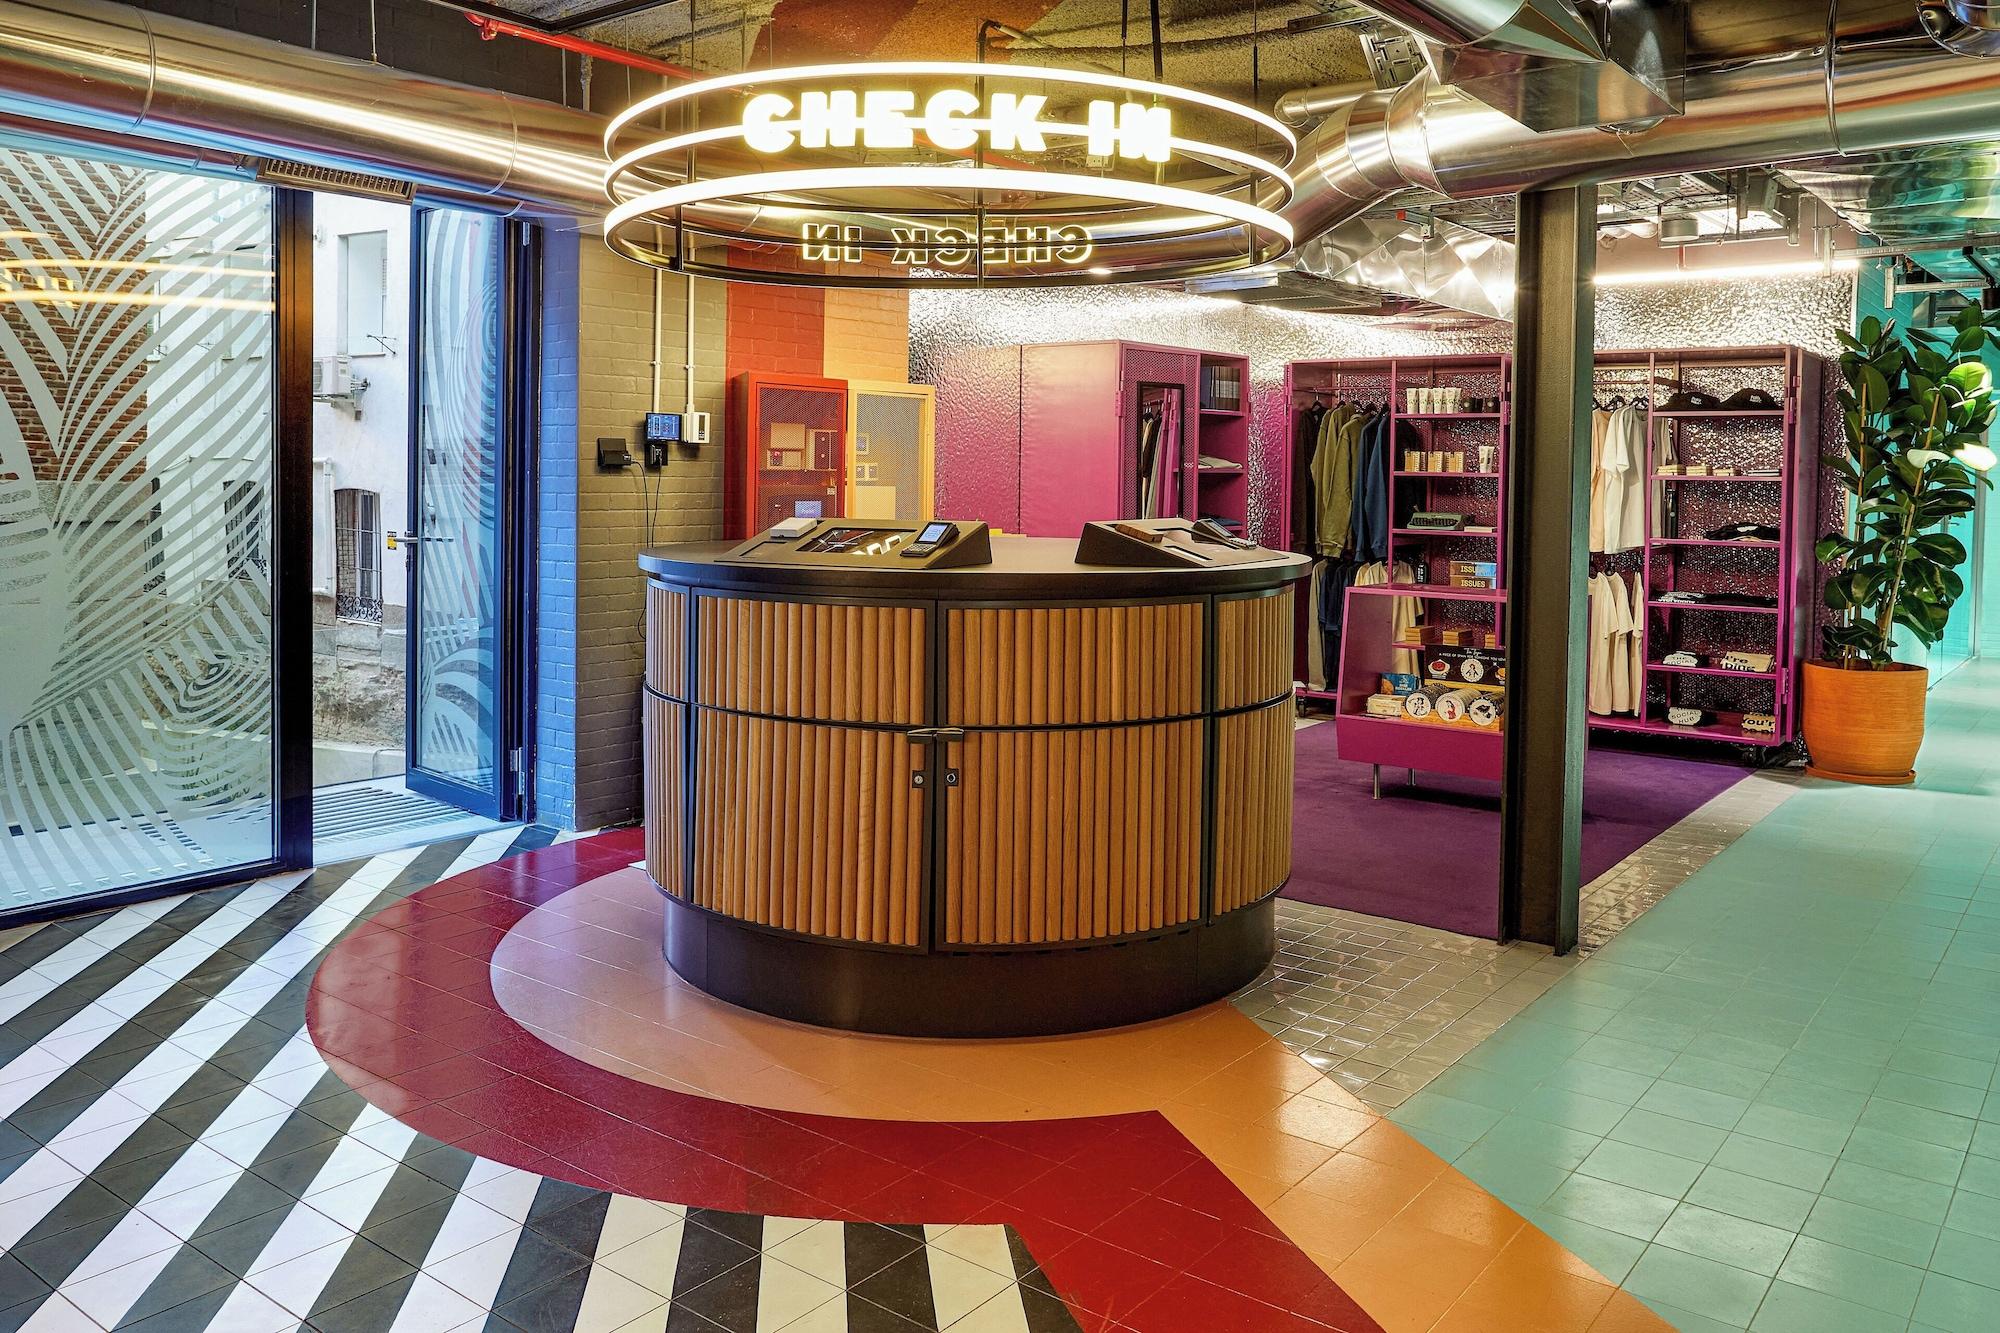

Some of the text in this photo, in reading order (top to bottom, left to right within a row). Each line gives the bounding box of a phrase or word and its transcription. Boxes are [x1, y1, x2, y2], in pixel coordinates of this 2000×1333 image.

[743, 89, 1171, 162] CHECK IN
[1460, 565, 1481, 573] ISSU
[1461, 579, 1486, 588] ISSUES
[1671, 711, 1699, 719] SOCIAL
[1678, 716, 1695, 724] HUB
